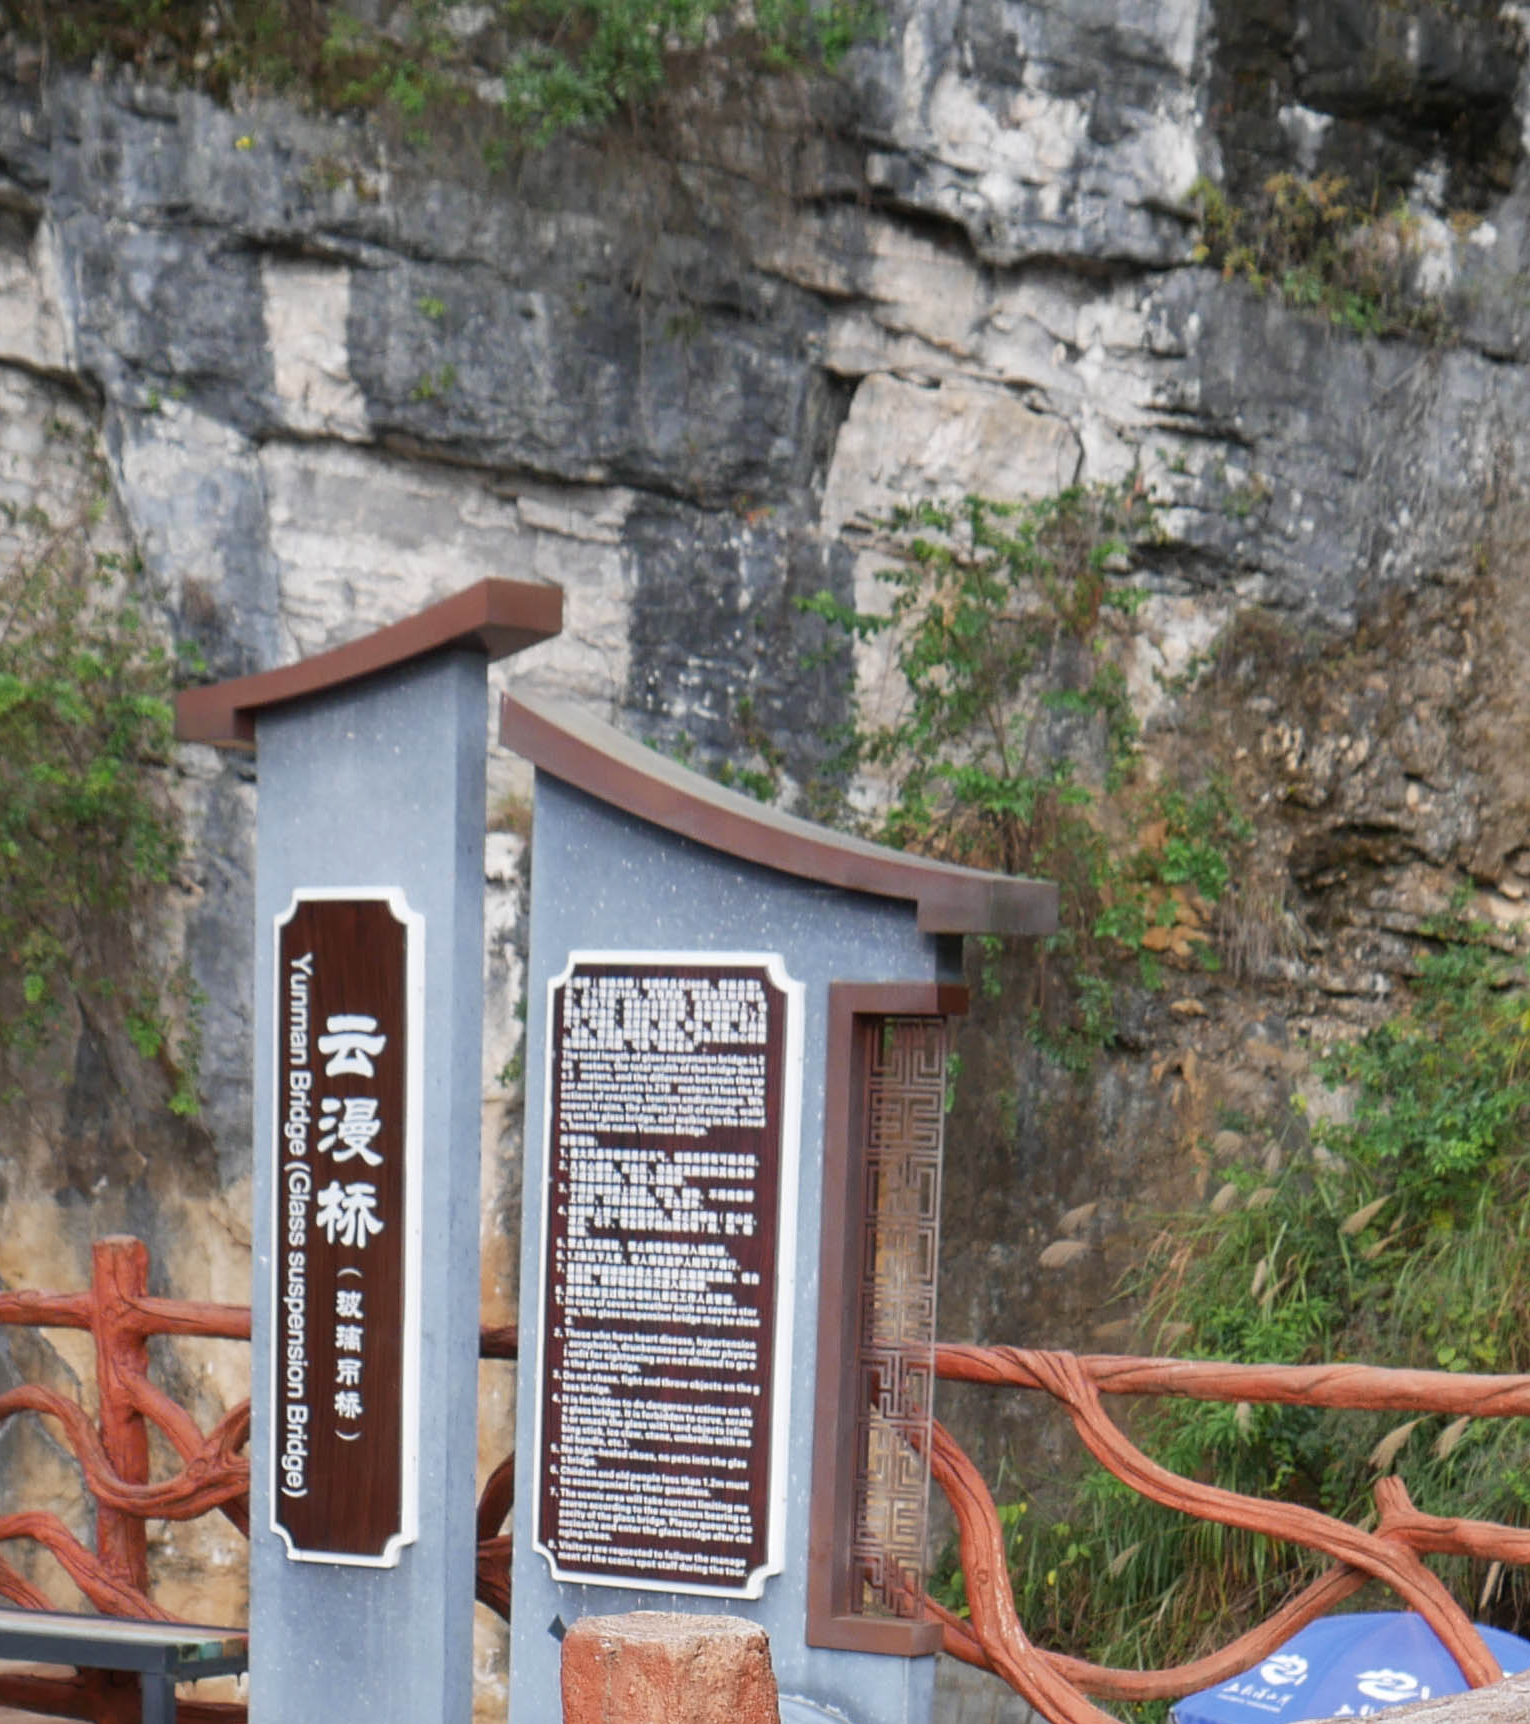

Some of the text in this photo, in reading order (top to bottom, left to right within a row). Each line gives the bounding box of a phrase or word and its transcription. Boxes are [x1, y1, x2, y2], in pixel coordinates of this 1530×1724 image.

[281, 952, 313, 1498] Yunman Bridge (Glass suspension Bridge)
[316, 1014, 387, 1249] 云漫桥
